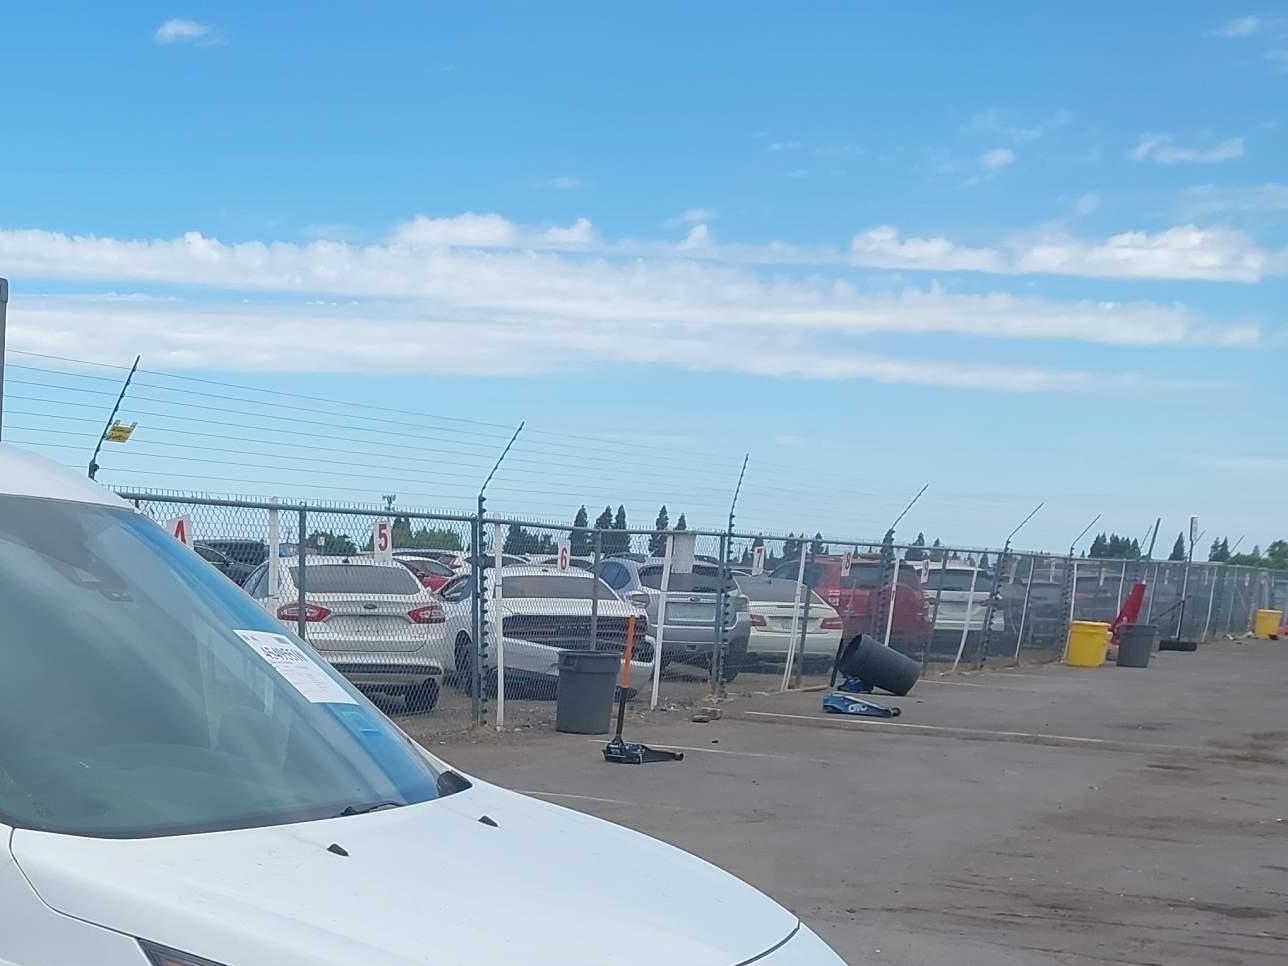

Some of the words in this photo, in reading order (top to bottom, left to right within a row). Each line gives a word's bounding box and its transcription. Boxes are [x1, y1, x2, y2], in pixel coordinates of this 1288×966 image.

[378, 523, 388, 552] 5
[560, 547, 568, 570] 6
[844, 552, 851, 570] 8
